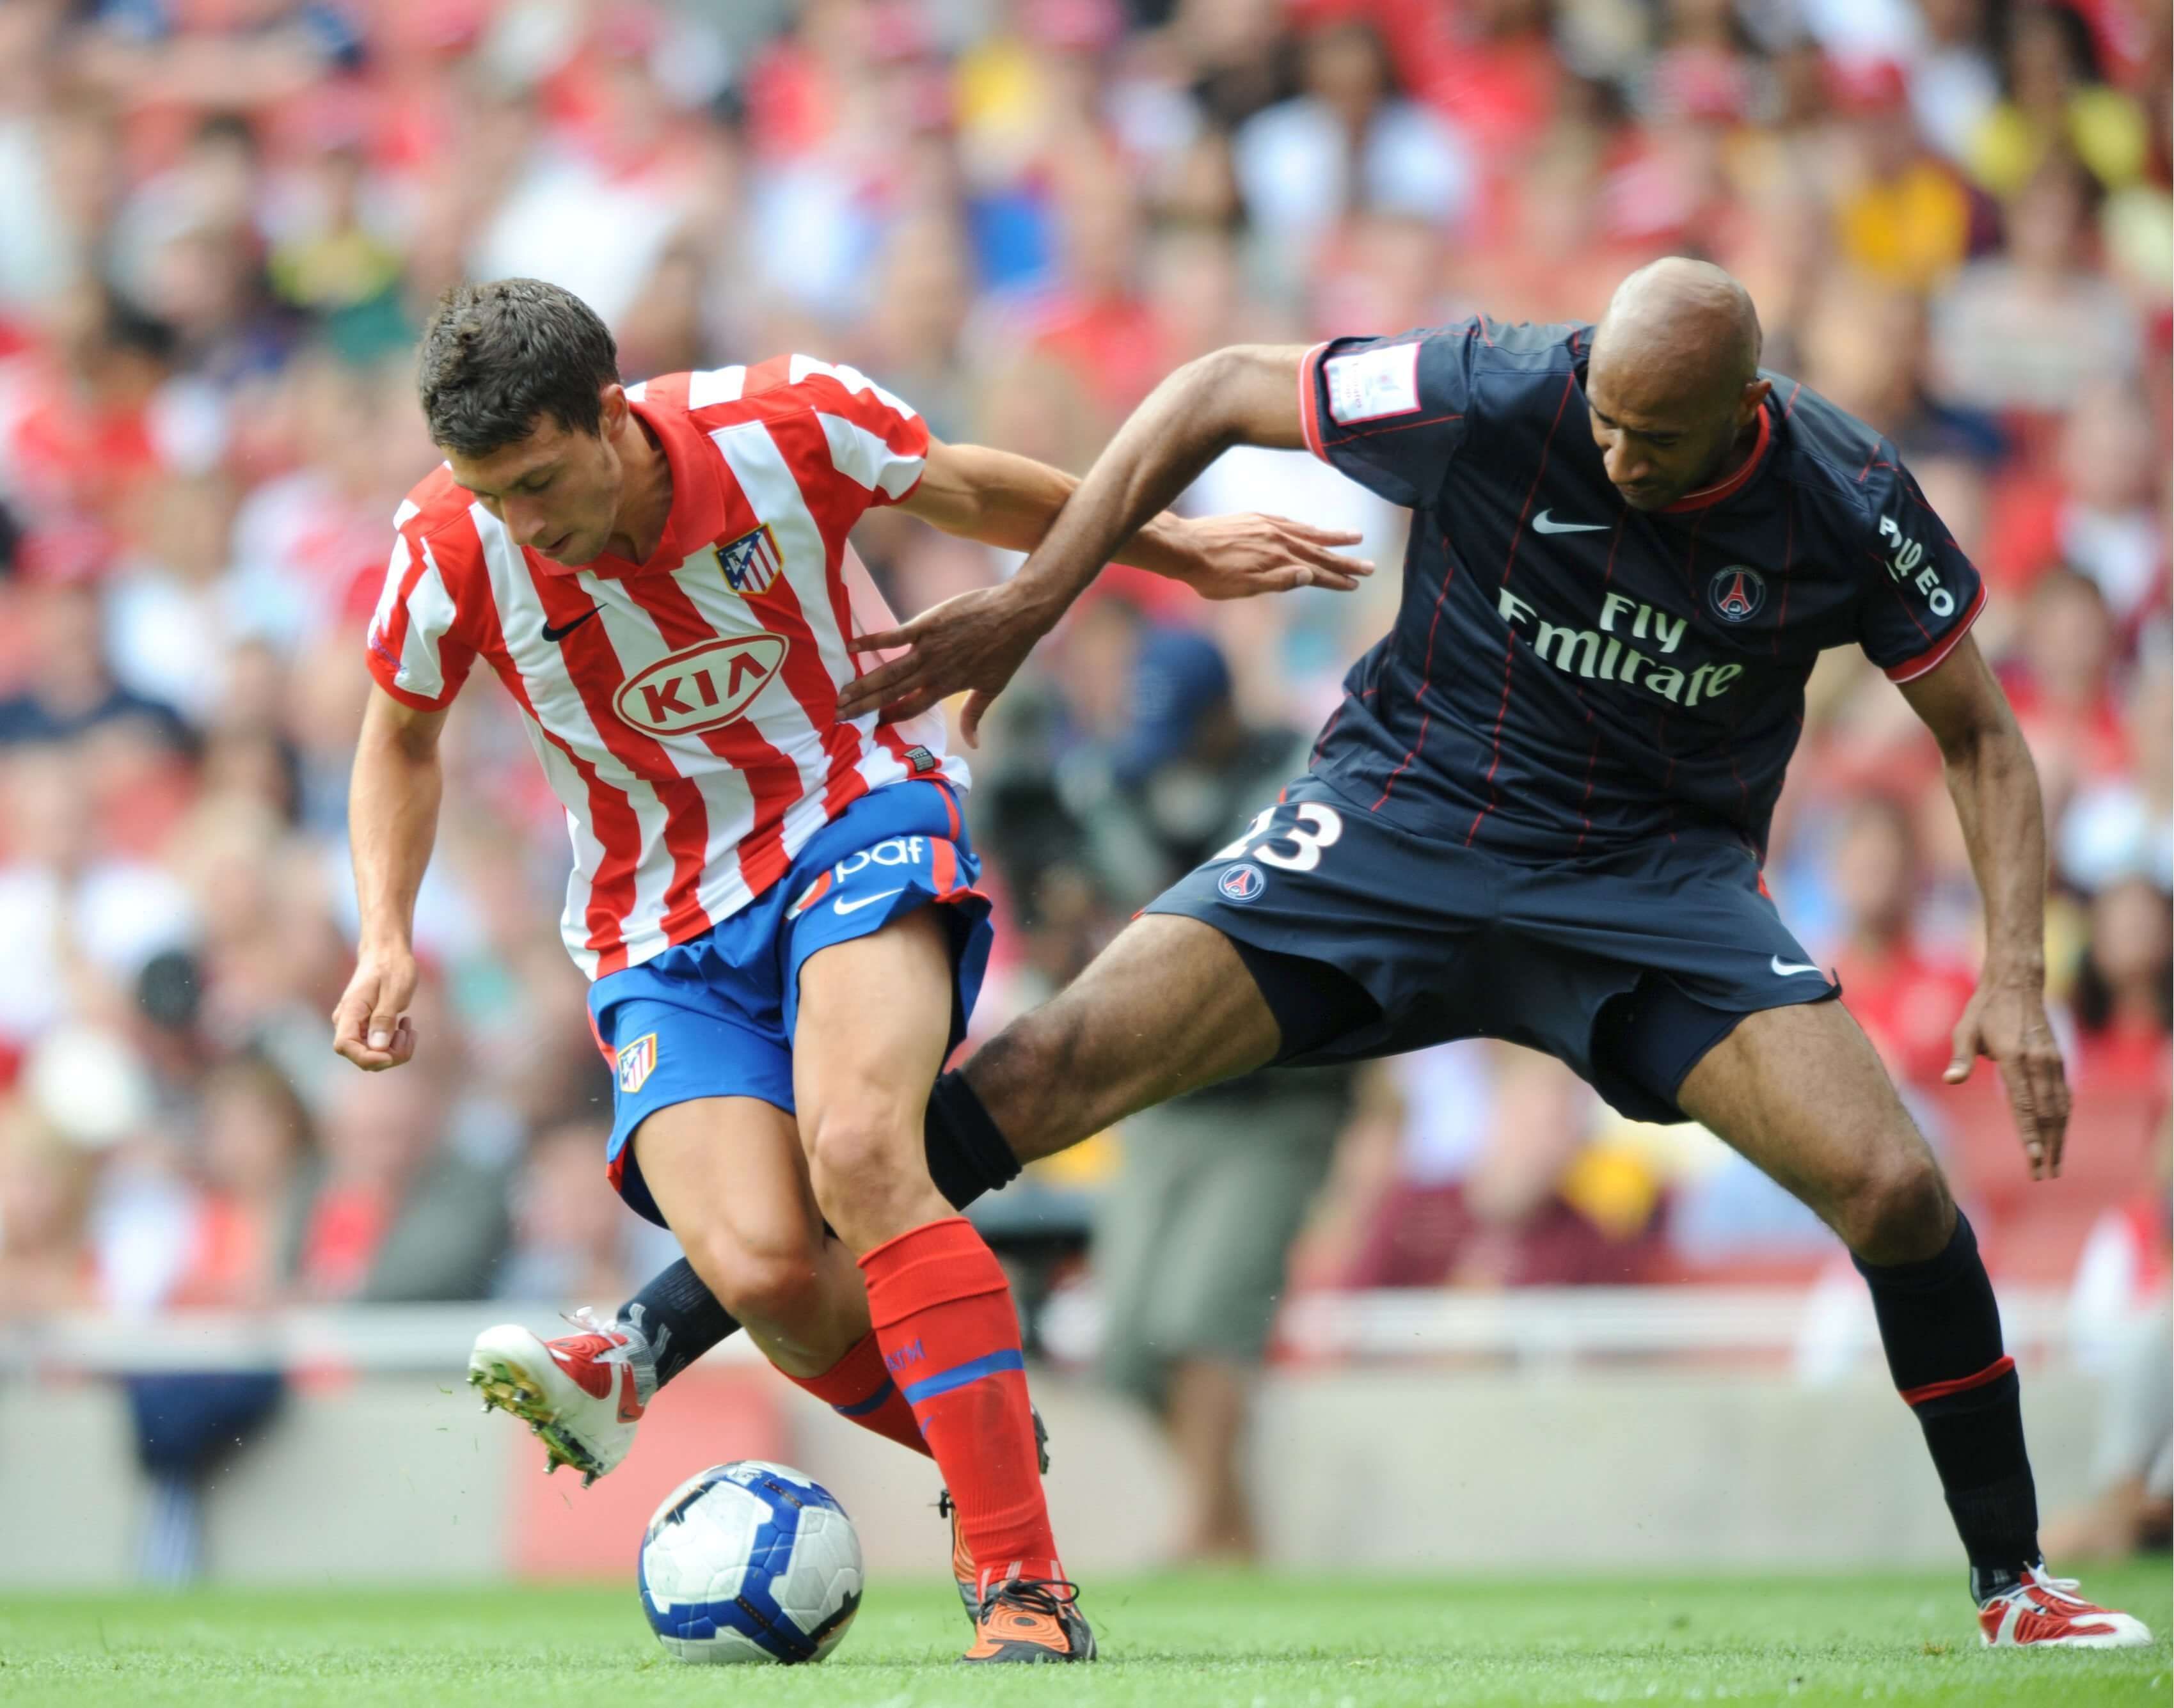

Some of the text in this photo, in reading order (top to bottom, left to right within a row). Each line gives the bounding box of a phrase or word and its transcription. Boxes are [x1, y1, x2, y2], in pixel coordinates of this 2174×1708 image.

[1498, 587, 1743, 706] Emirate
[1600, 592, 1688, 653] Fly
[639, 652, 768, 724] KIA
[835, 837, 923, 883] paf
